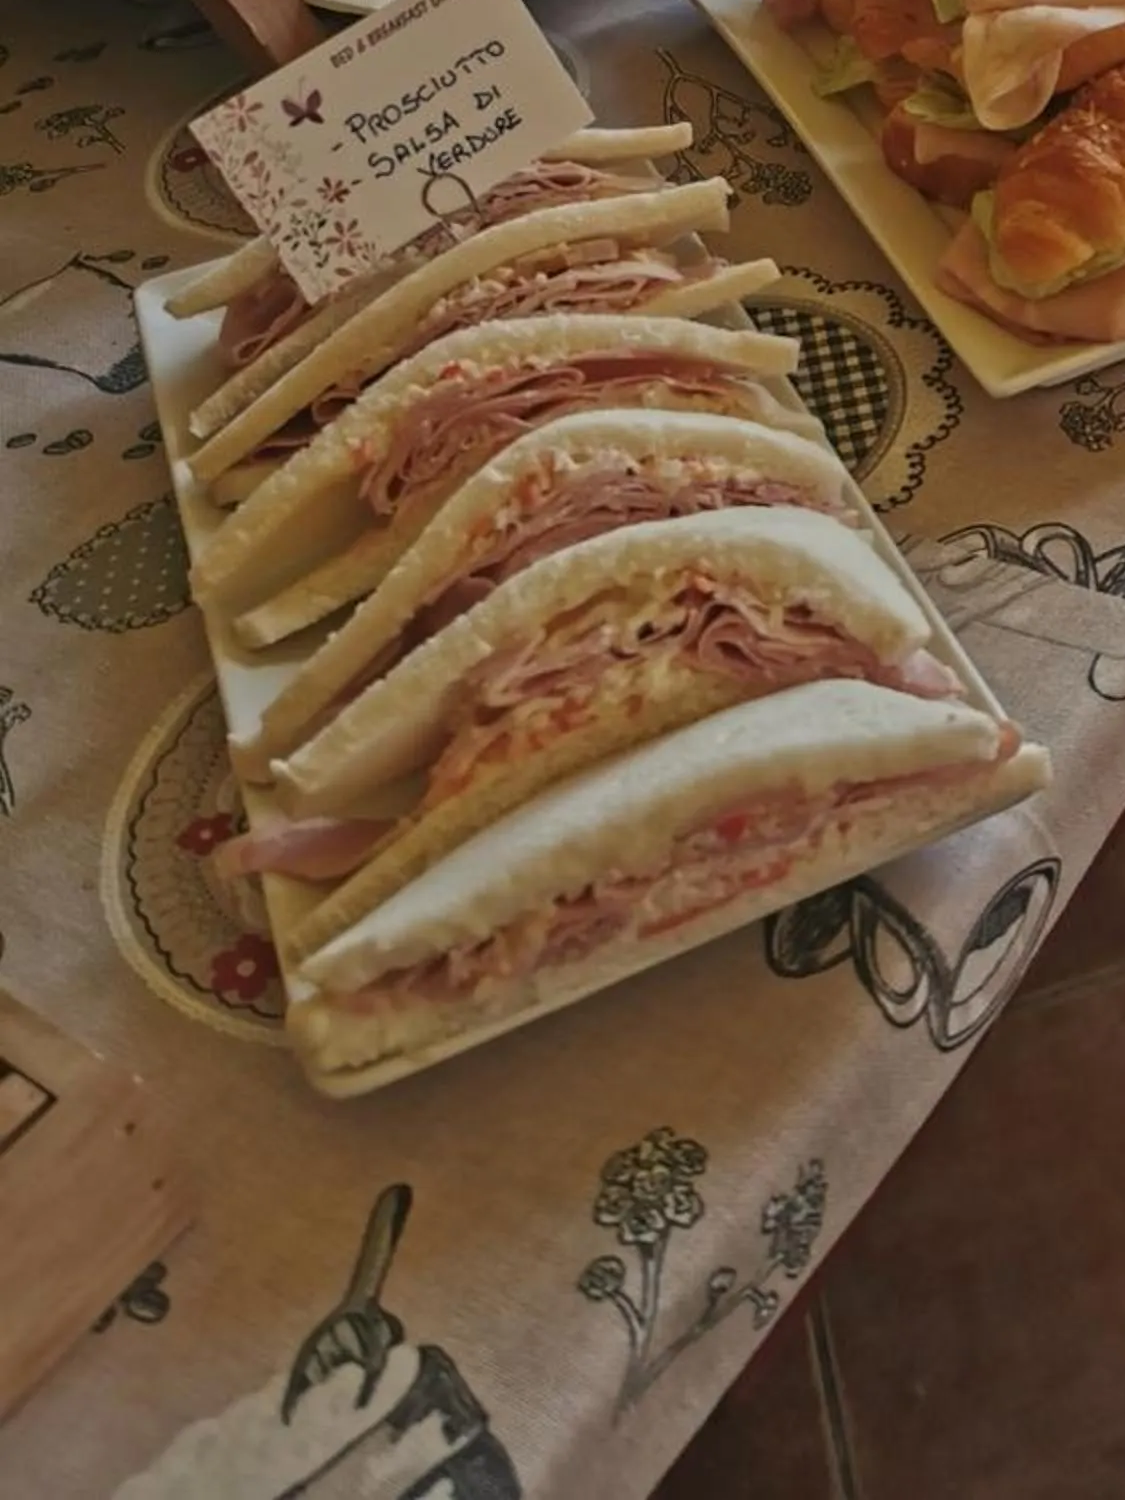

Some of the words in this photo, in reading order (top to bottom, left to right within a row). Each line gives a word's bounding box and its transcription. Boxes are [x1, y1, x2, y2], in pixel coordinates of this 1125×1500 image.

[330, 48, 354, 69] BED
[345, 39, 506, 144] PROSCIUTTO
[368, 111, 460, 179] SALSA
[474, 85, 503, 112] DI
[417, 107, 523, 178] VERDURE
